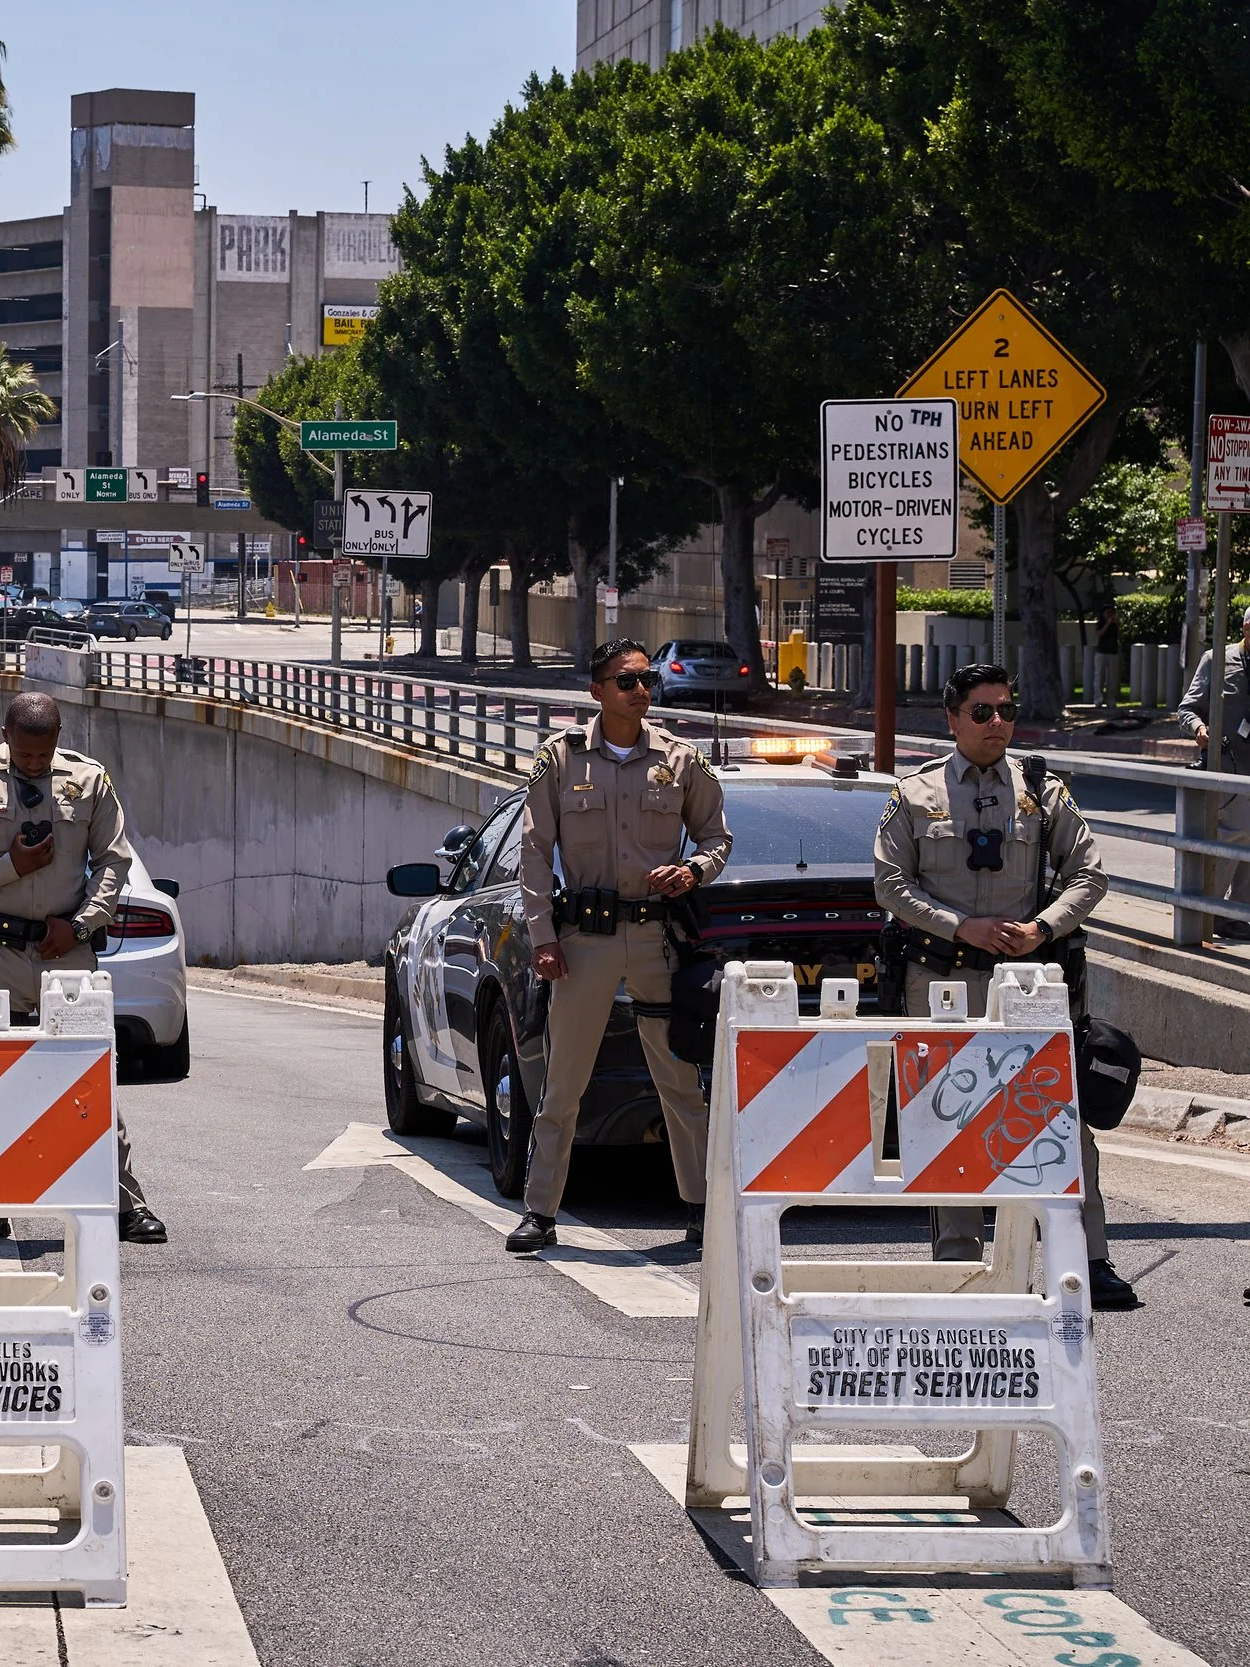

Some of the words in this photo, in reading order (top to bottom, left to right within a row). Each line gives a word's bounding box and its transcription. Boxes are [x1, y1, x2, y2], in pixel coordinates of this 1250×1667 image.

[220, 224, 286, 272] PARK
[327, 308, 360, 317] Gonzales
[334, 319, 355, 328] BAIL
[994, 337, 1009, 358] 2
[944, 369, 988, 389] LEFT
[999, 369, 1059, 389] LANES
[910, 409, 943, 428] TPH
[958, 401, 999, 420] URN
[1008, 400, 1054, 419] LEFT
[875, 414, 904, 432] NO
[308, 429, 366, 441] Alameda
[373, 429, 389, 441] St
[969, 431, 1033, 451] AHEAD
[831, 441, 950, 461] PEDESTRIANS
[1210, 435, 1225, 460] NO
[1225, 439, 1250, 458] STOPPI
[89, 472, 123, 480] Alameda
[848, 471, 933, 490] BICYCLES
[1214, 466, 1231, 481] ANY
[1235, 466, 1250, 482] TIM
[128, 492, 141, 500] BUS
[321, 505, 344, 516] UNI
[829, 499, 952, 518] MOTOR-DRIVEN
[317, 519, 343, 531] STATI
[374, 530, 394, 539] BUS
[856, 527, 924, 546] CYCLES
[345, 541, 370, 551] ONLY
[371, 542, 396, 552] ONLY
[740, 910, 881, 922] DODG
[833, 1328, 868, 1344] CITY
[874, 1328, 894, 1344] OF
[899, 1328, 930, 1345] LOS
[935, 1328, 1008, 1345] ANGELES
[808, 1346, 860, 1367] DEPT.
[867, 1346, 890, 1367] OF
[896, 1347, 963, 1368] PUBLIC
[968, 1347, 1036, 1369] WORKS
[807, 1370, 907, 1398] STREET
[913, 1370, 1040, 1399] SERVICES
